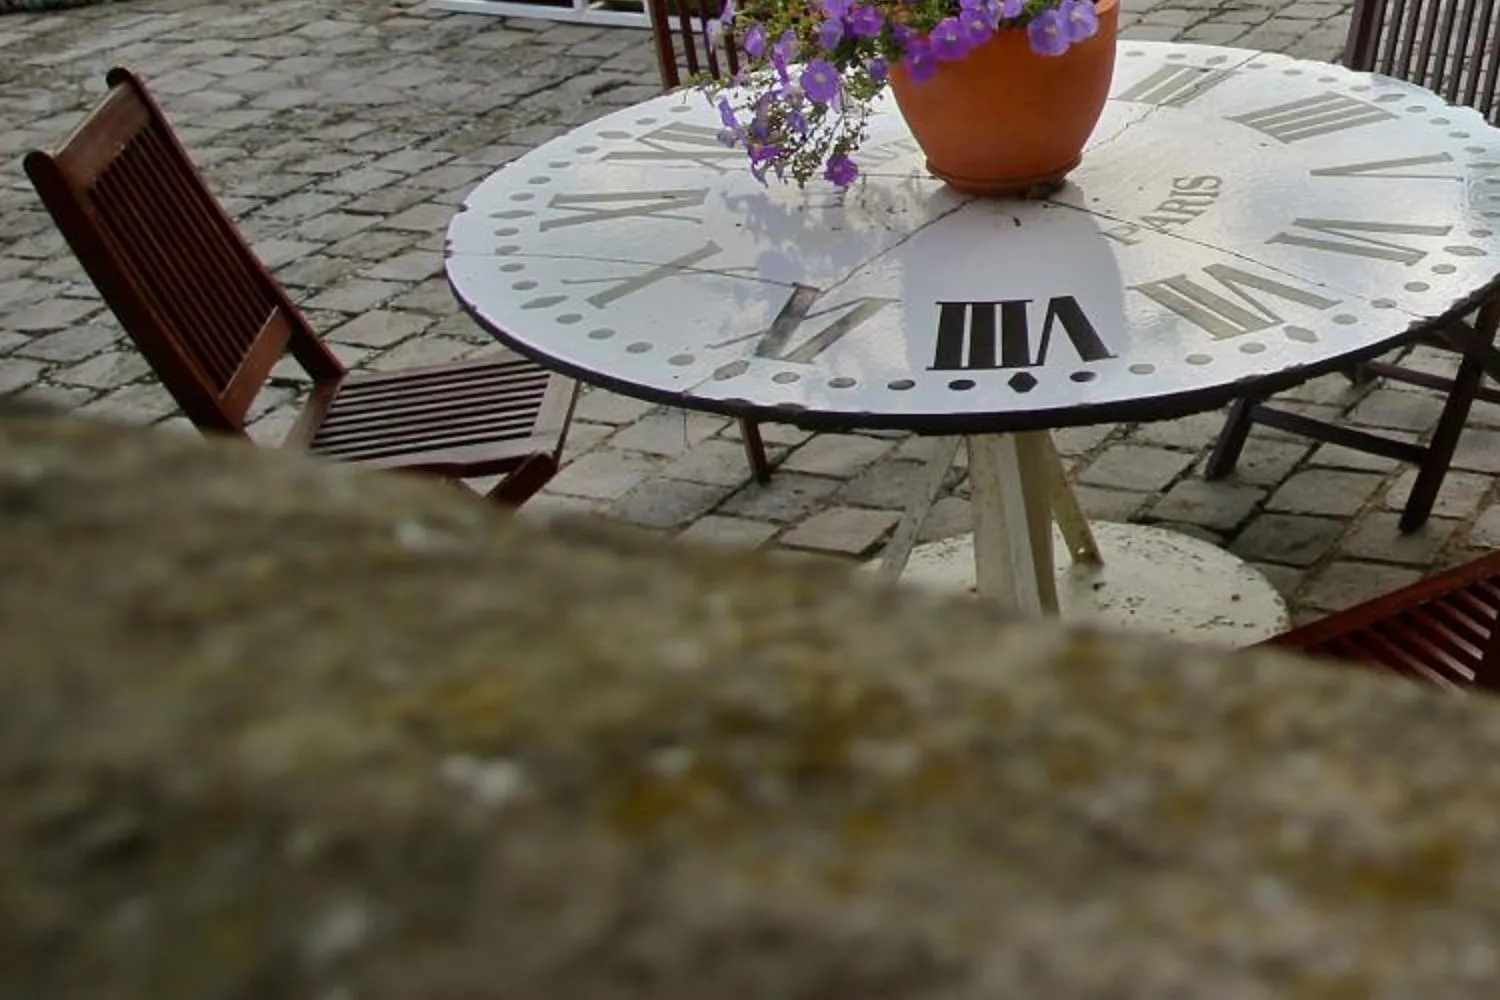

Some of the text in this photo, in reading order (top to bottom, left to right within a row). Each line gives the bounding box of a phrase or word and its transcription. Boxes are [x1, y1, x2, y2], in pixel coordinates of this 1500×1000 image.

[1310, 151, 1464, 182] V
[1097, 174, 1223, 246] PARIS
[926, 296, 1119, 371] VIII
